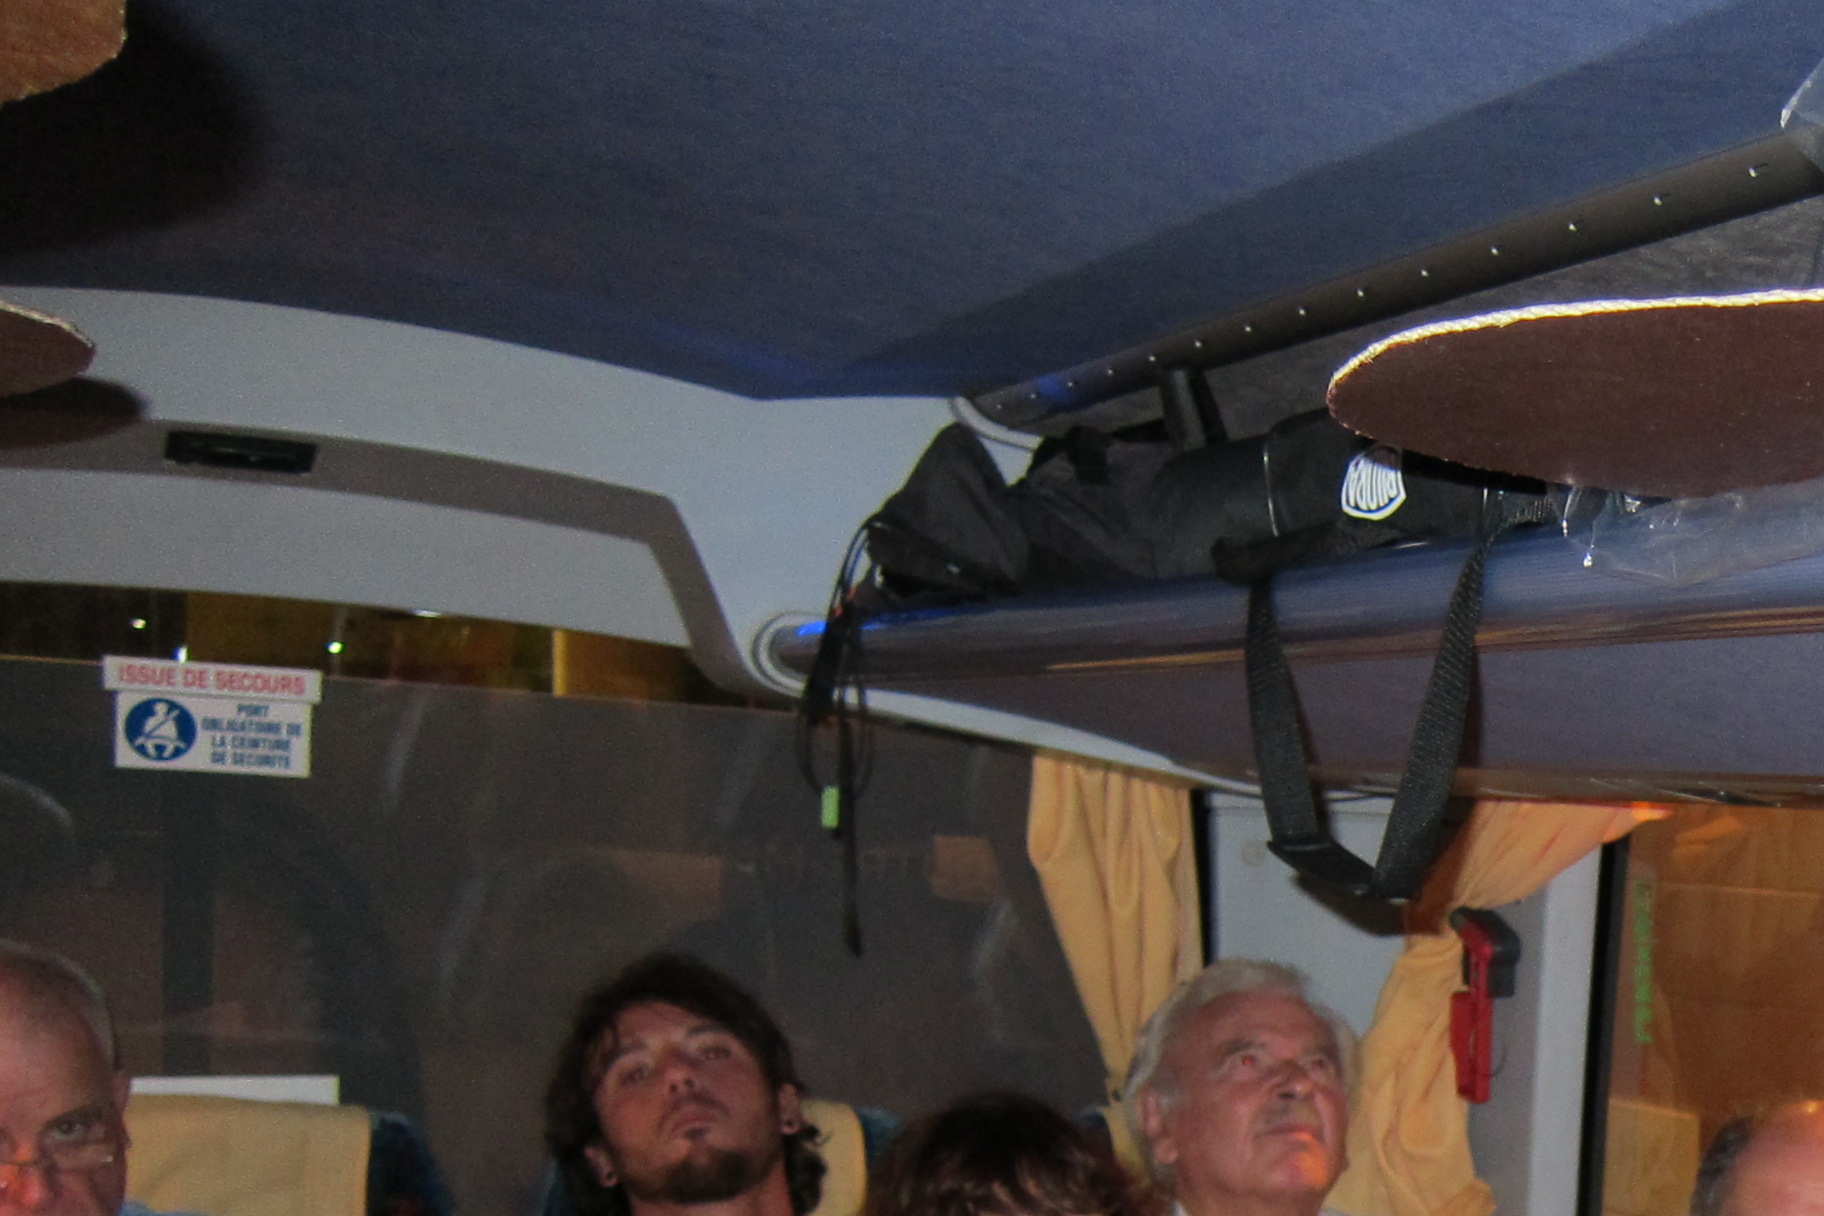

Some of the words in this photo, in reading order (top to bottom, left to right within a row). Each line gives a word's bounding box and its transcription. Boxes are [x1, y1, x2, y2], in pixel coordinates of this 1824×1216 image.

[120, 664, 176, 686] ISSUE
[184, 669, 208, 688] DE
[216, 671, 306, 695] SECOURS
